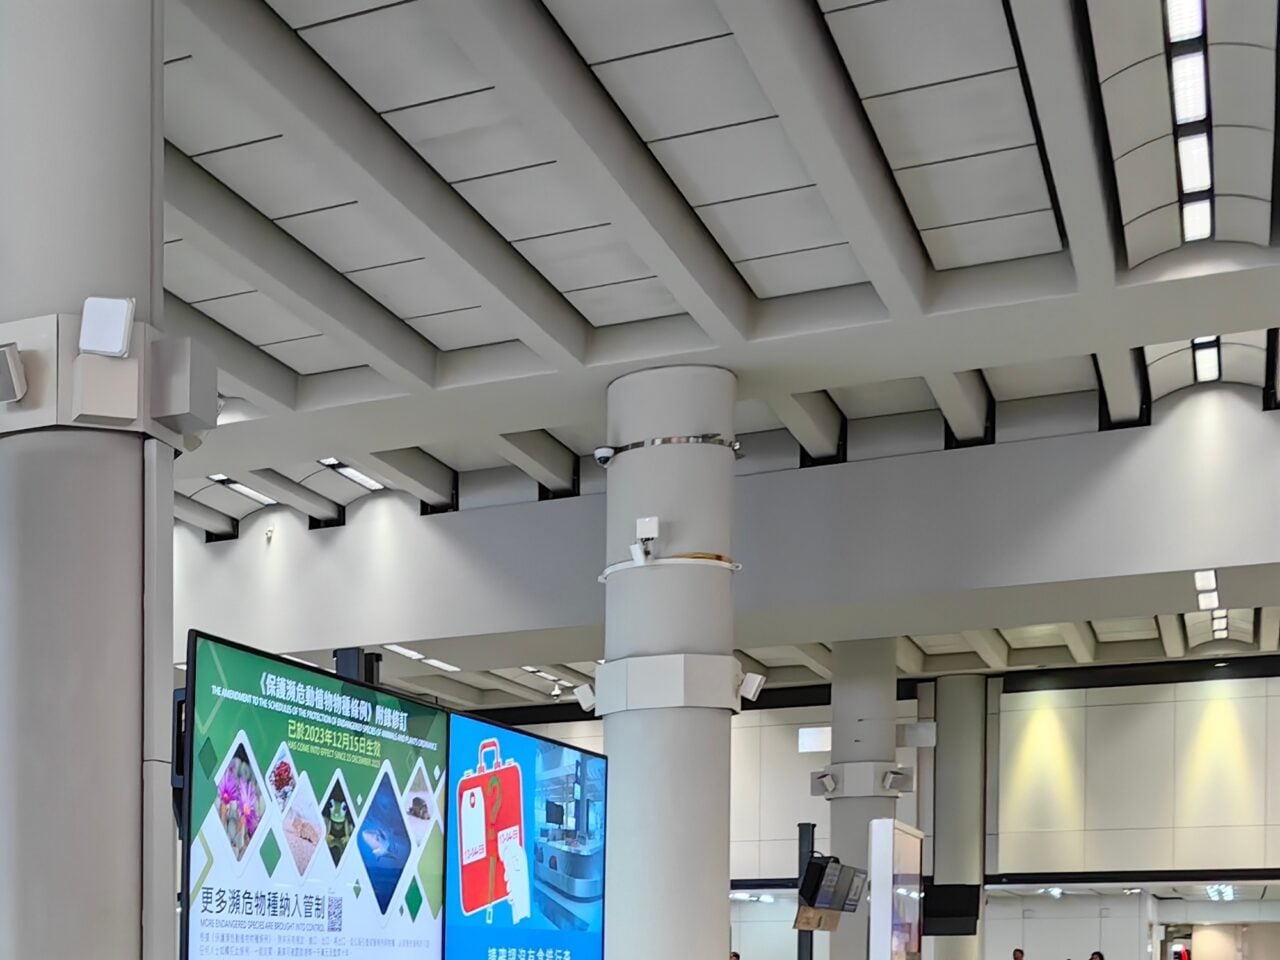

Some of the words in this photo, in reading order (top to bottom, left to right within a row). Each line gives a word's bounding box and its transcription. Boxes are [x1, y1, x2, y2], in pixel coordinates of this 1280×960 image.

[201, 886, 325, 920] 更多瀕危物種納入管制
